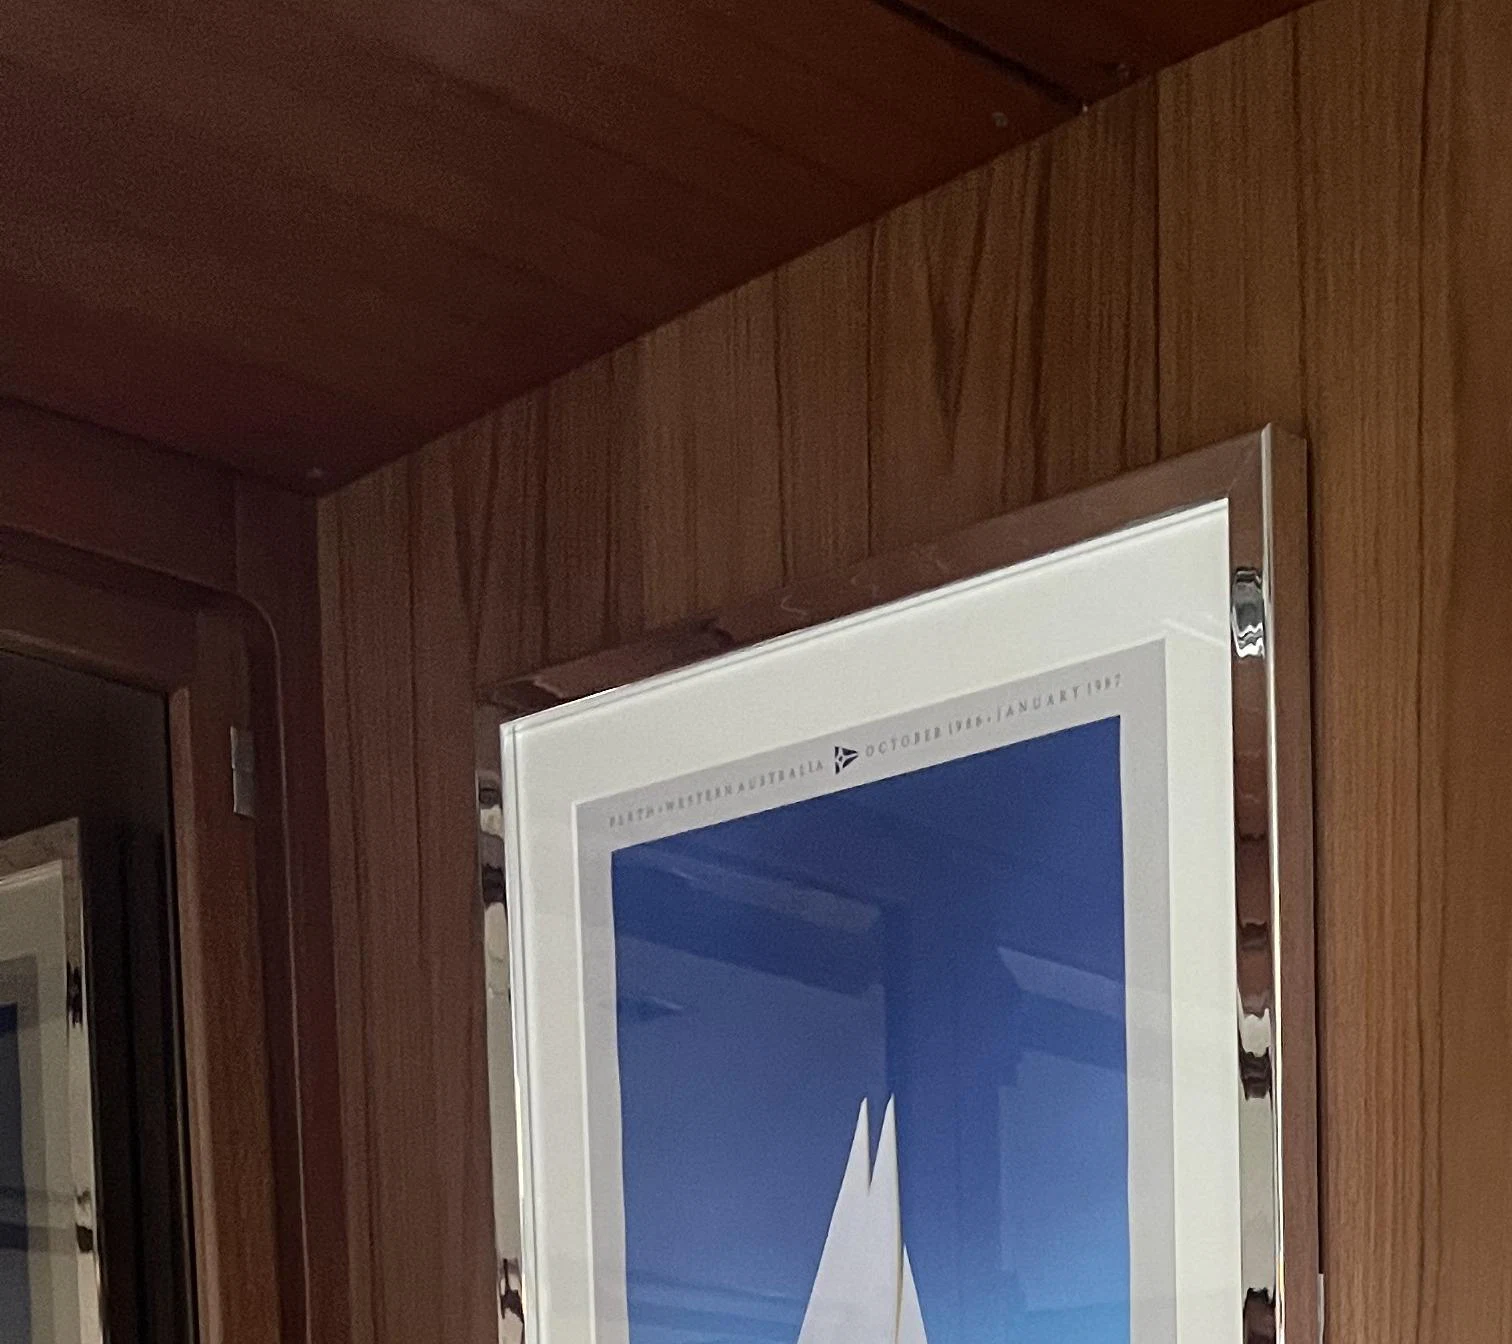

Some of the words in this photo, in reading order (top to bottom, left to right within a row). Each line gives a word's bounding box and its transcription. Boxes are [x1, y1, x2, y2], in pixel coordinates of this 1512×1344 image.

[665, 784, 732, 812] WESTERN
[737, 760, 824, 794] AUSTRALIA
[865, 726, 941, 757] OCTOBER
[997, 685, 1079, 723] JANUARY
